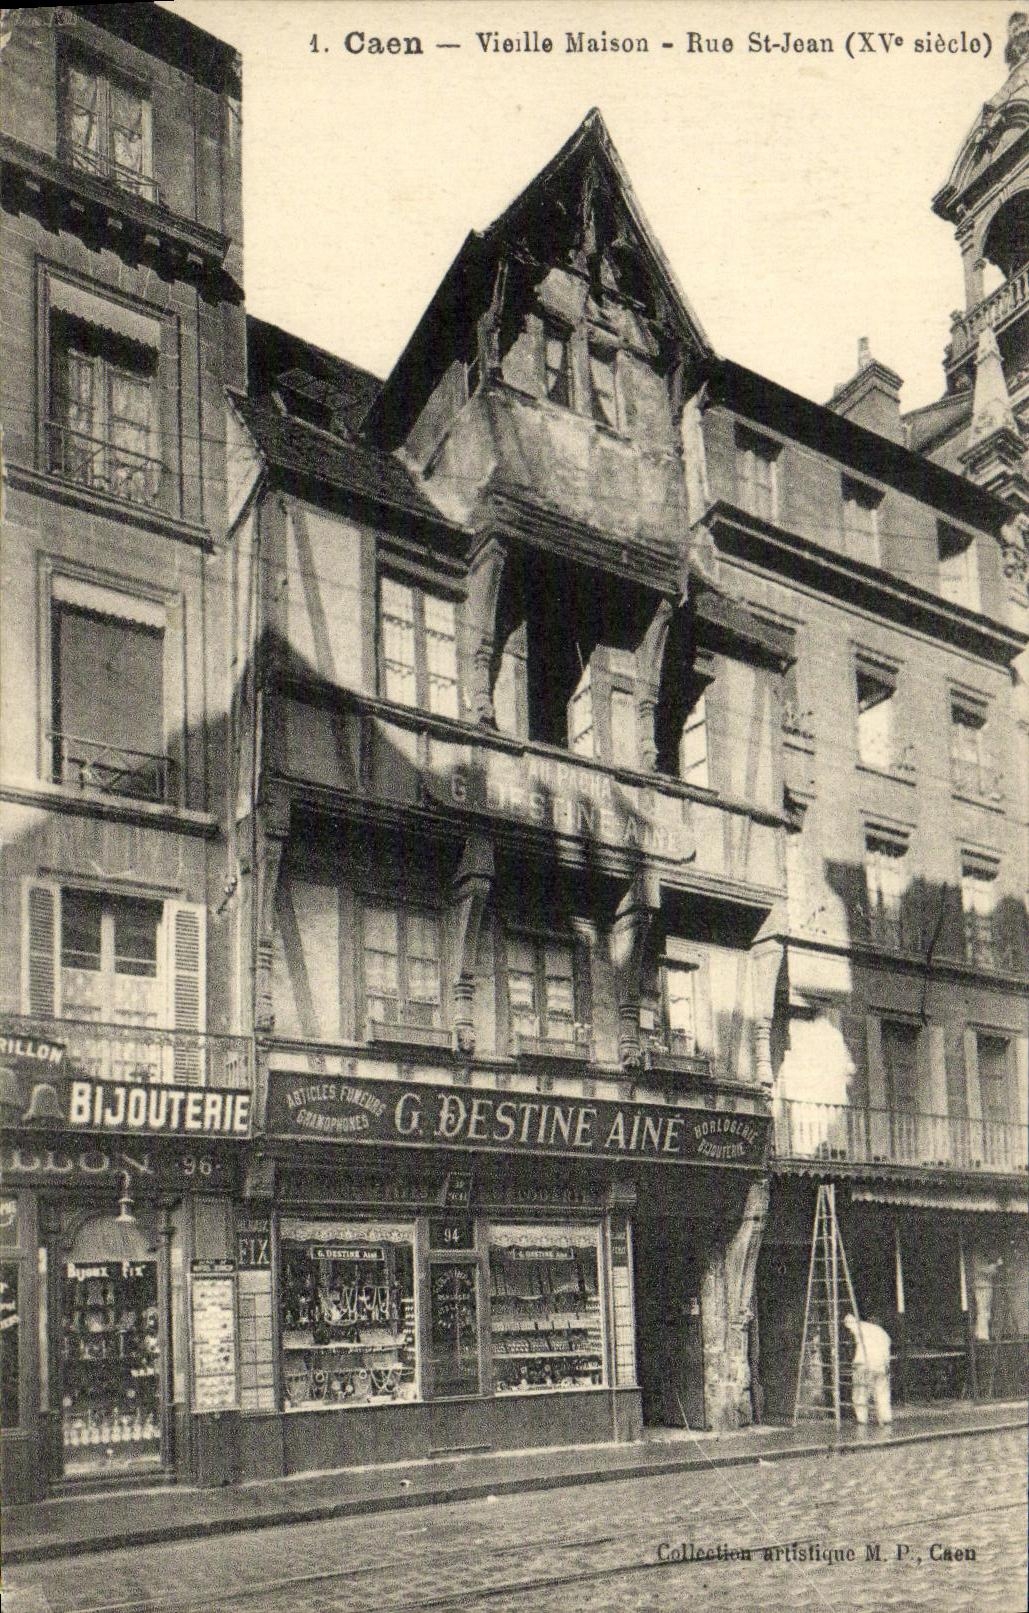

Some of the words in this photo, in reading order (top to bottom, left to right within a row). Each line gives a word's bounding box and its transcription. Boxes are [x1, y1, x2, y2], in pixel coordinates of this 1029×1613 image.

[70, 1081, 251, 1132] BIJOUTERIE
[285, 1083, 337, 1109] ARTICLES
[340, 1084, 388, 1117] FUMEURS
[296, 1108, 370, 1133] GRAMOPHONES
[693, 1117, 759, 1145] HORLOGERIE
[443, 1227, 461, 1243] 94
[238, 1238, 270, 1265] FIX
